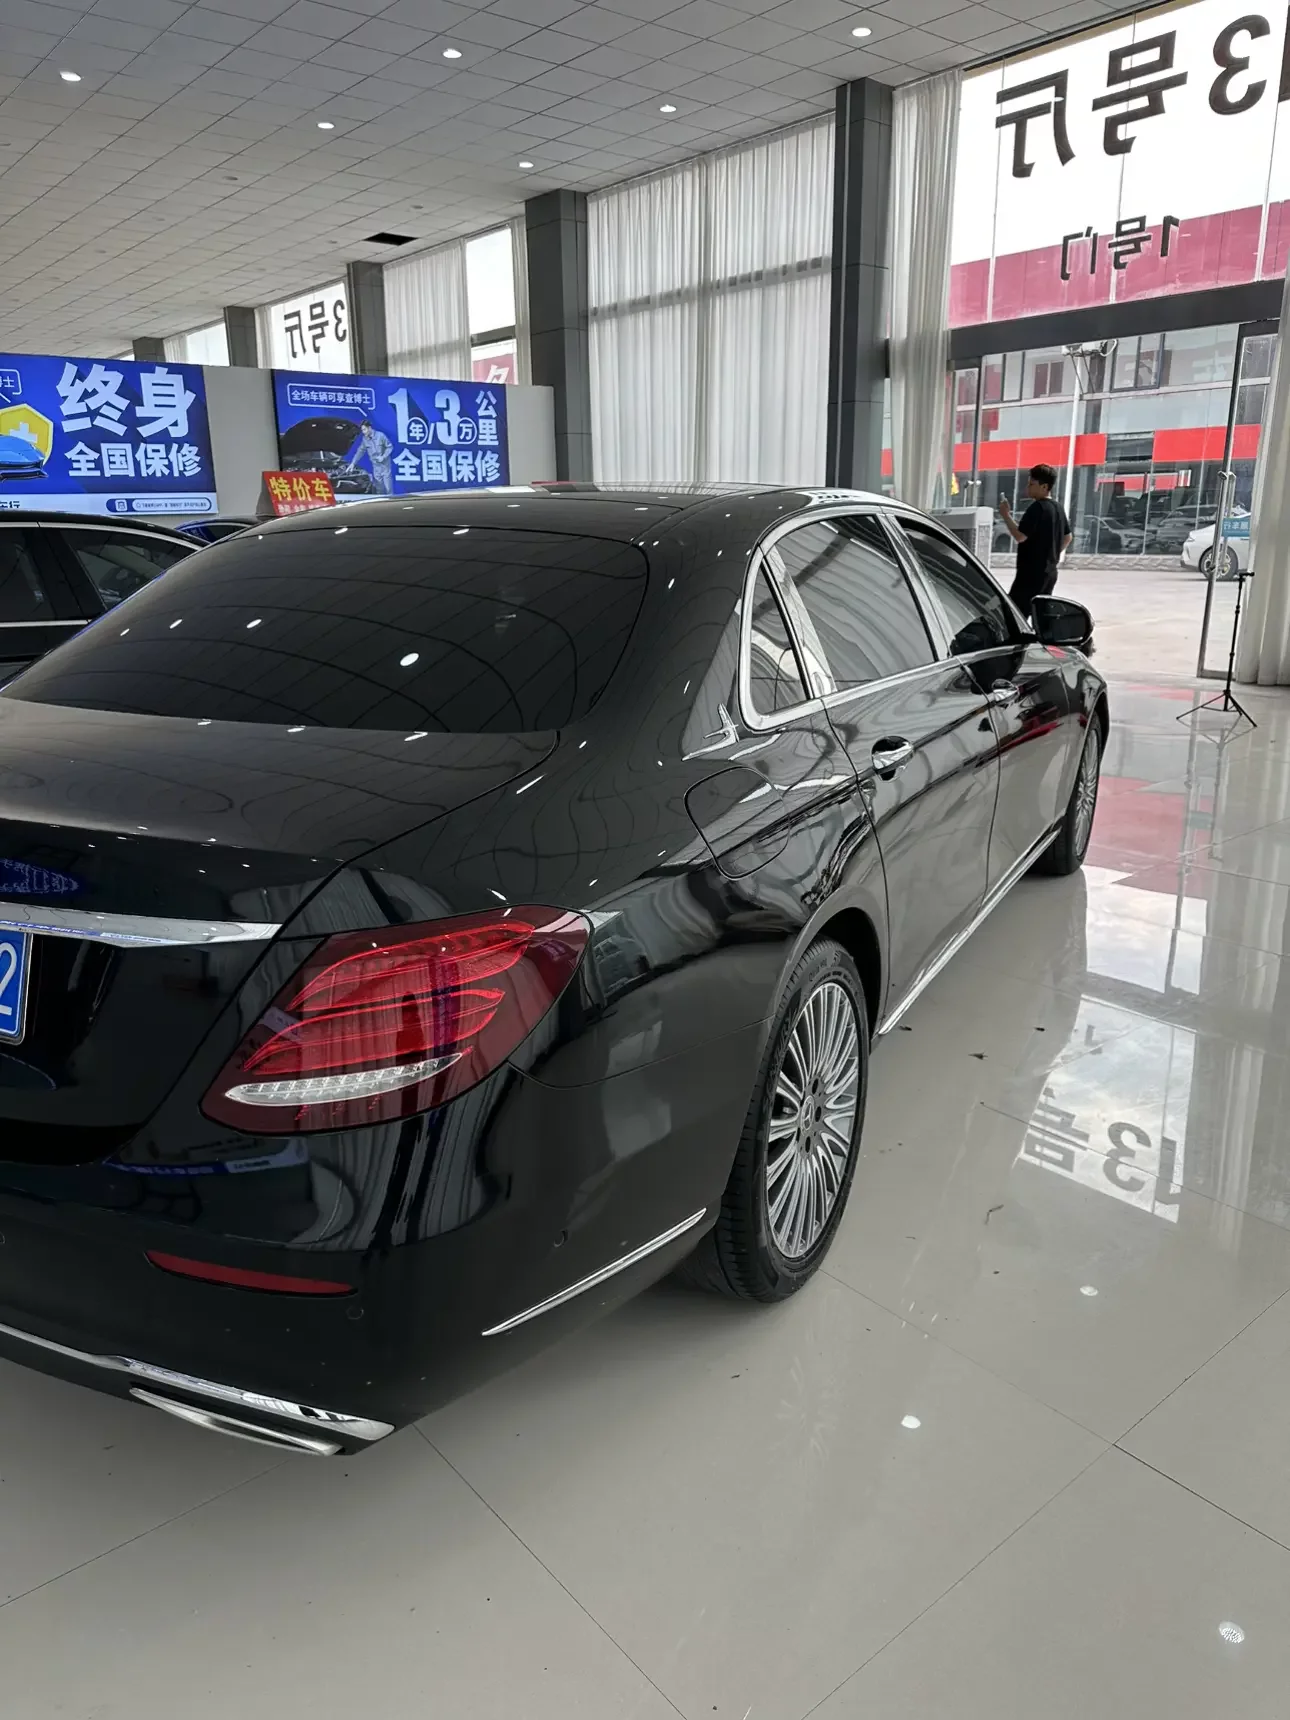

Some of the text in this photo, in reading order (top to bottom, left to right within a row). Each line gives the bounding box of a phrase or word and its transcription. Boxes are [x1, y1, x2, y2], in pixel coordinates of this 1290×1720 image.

[56, 361, 196, 438] 终身
[64, 441, 201, 477] 全国保修
[392, 448, 500, 483] 全国保修
[269, 476, 332, 502] 特价车
